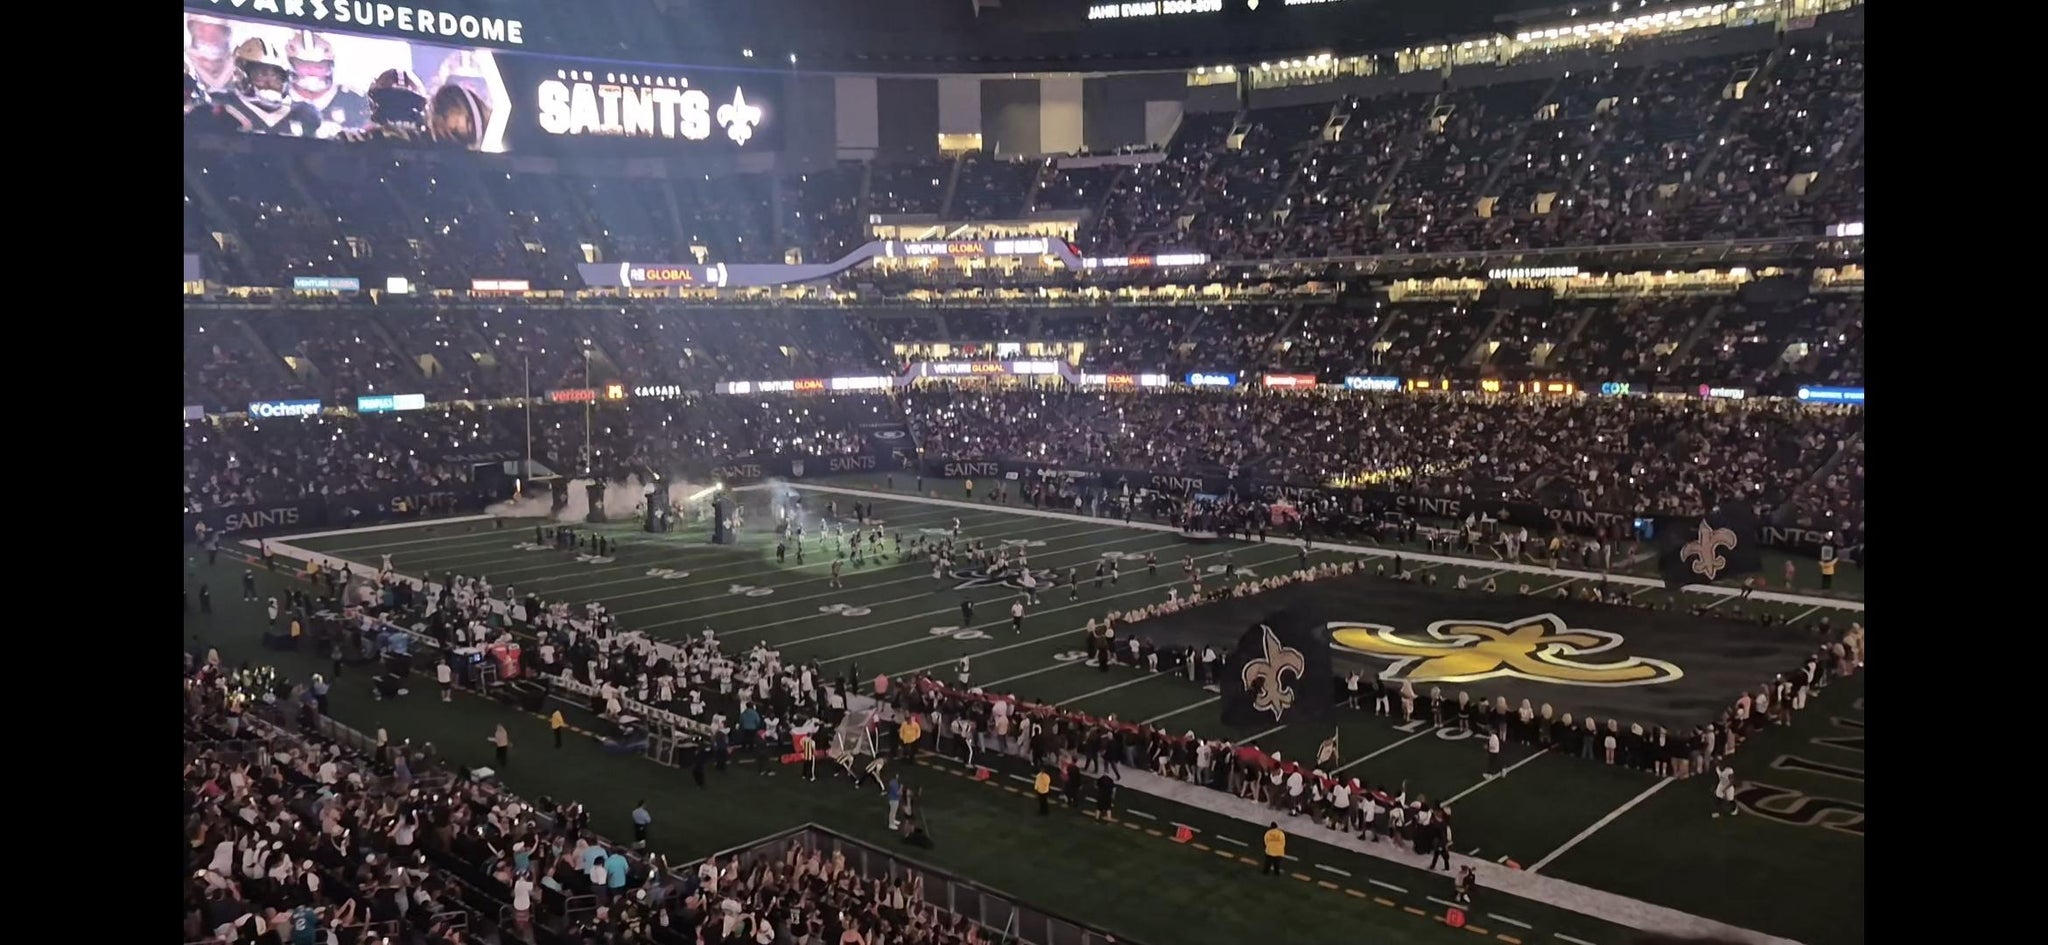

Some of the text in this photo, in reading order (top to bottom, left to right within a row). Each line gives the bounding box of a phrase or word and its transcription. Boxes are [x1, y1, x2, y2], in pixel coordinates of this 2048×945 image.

[335, 0, 523, 44] SUPERDOME
[538, 80, 711, 140] SAINTS
[948, 243, 984, 253] GLOBAL
[646, 269, 692, 281] GLOBAL
[972, 364, 1004, 373] GLOBAL
[1353, 378, 1397, 390] Ochsner
[1602, 382, 1630, 395] COX
[552, 388, 595, 401] verizon
[260, 402, 320, 417] Ochsner
[830, 456, 876, 471] SAINTS
[945, 462, 999, 477] SAINTS
[225, 508, 298, 531] SAINTS
[1392, 718, 1474, 741] 10
